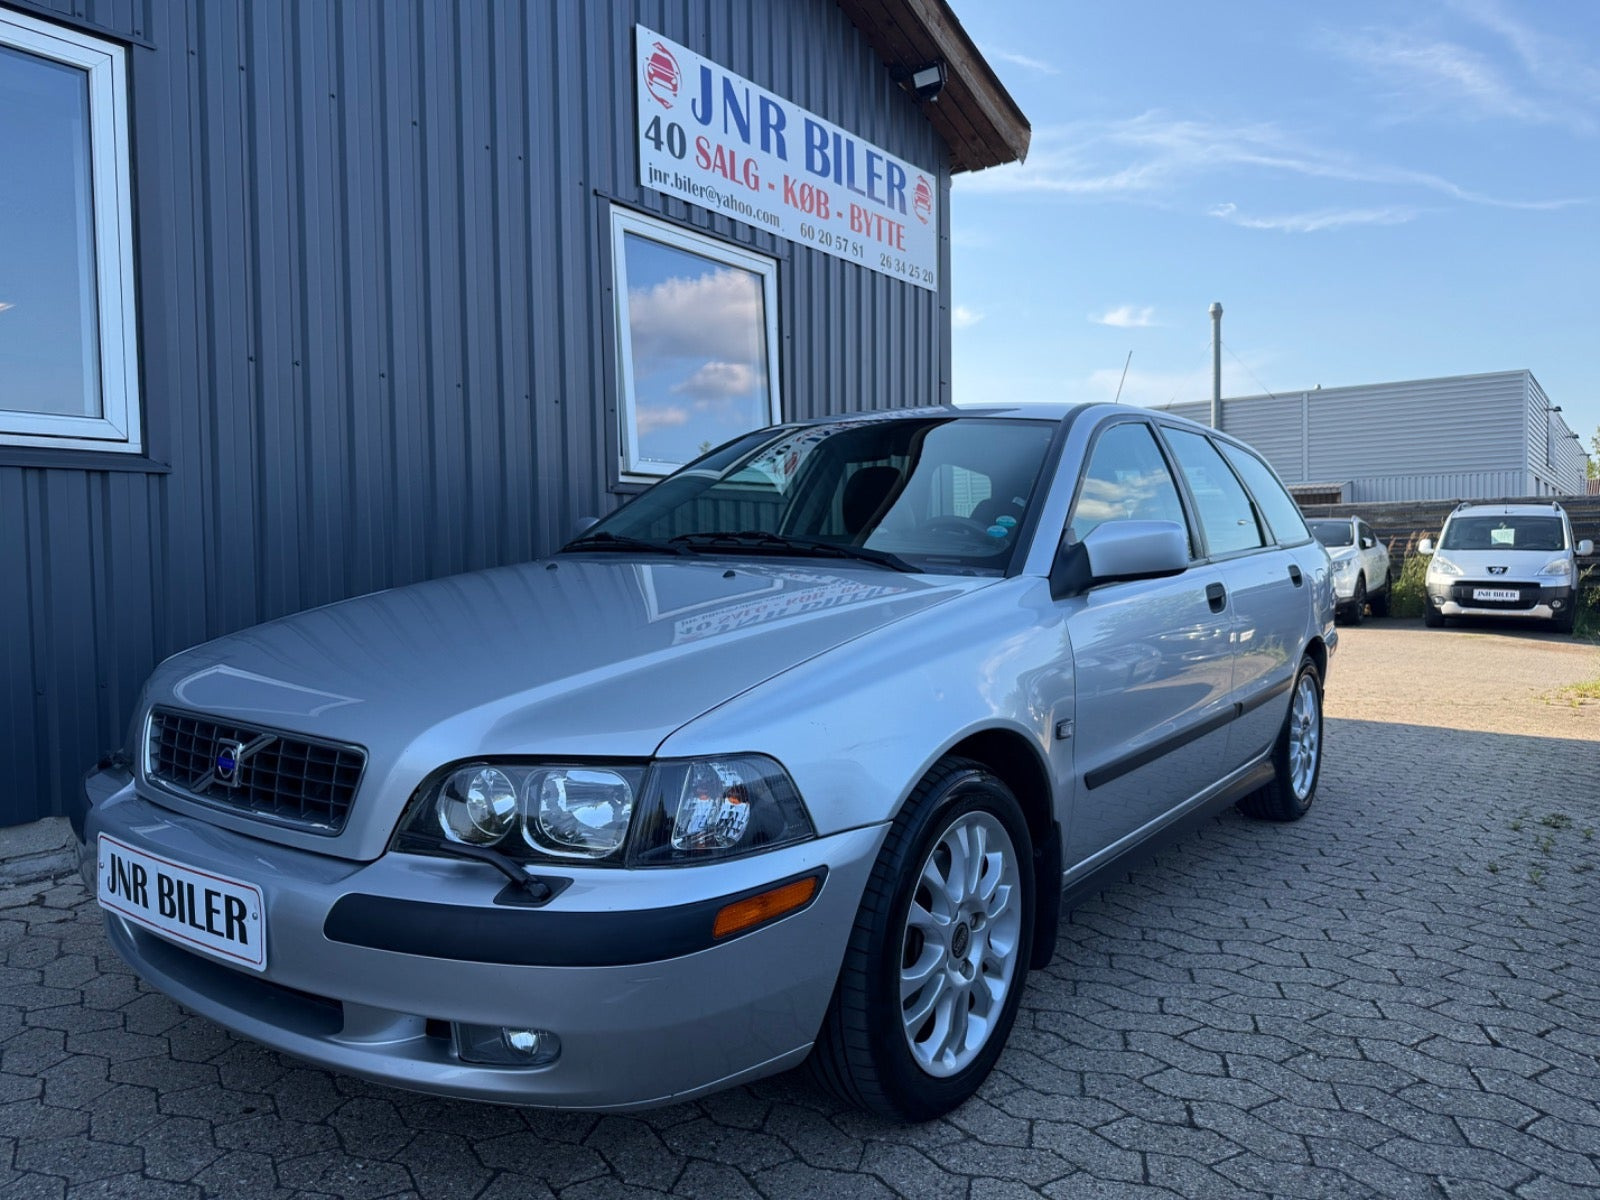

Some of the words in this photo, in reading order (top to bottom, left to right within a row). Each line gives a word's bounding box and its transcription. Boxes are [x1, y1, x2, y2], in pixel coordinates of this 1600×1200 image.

[644, 114, 688, 160] 40
[691, 64, 788, 162] JNR
[804, 117, 908, 216] BILER
[648, 162, 781, 228] jnr.biler@yahoo.com
[695, 135, 760, 192] SALG
[783, 173, 831, 221] KØB
[849, 202, 907, 252] BYTTE
[800, 221, 815, 241] 60
[818, 228, 832, 248] 20
[835, 236, 849, 253] 57
[851, 242, 864, 259] 81
[879, 252, 893, 270] 26
[894, 258, 907, 275] 34
[908, 263, 920, 279] 25
[922, 268, 934, 285] 20
[107, 853, 149, 909] JNR
[157, 872, 248, 945] BILER
